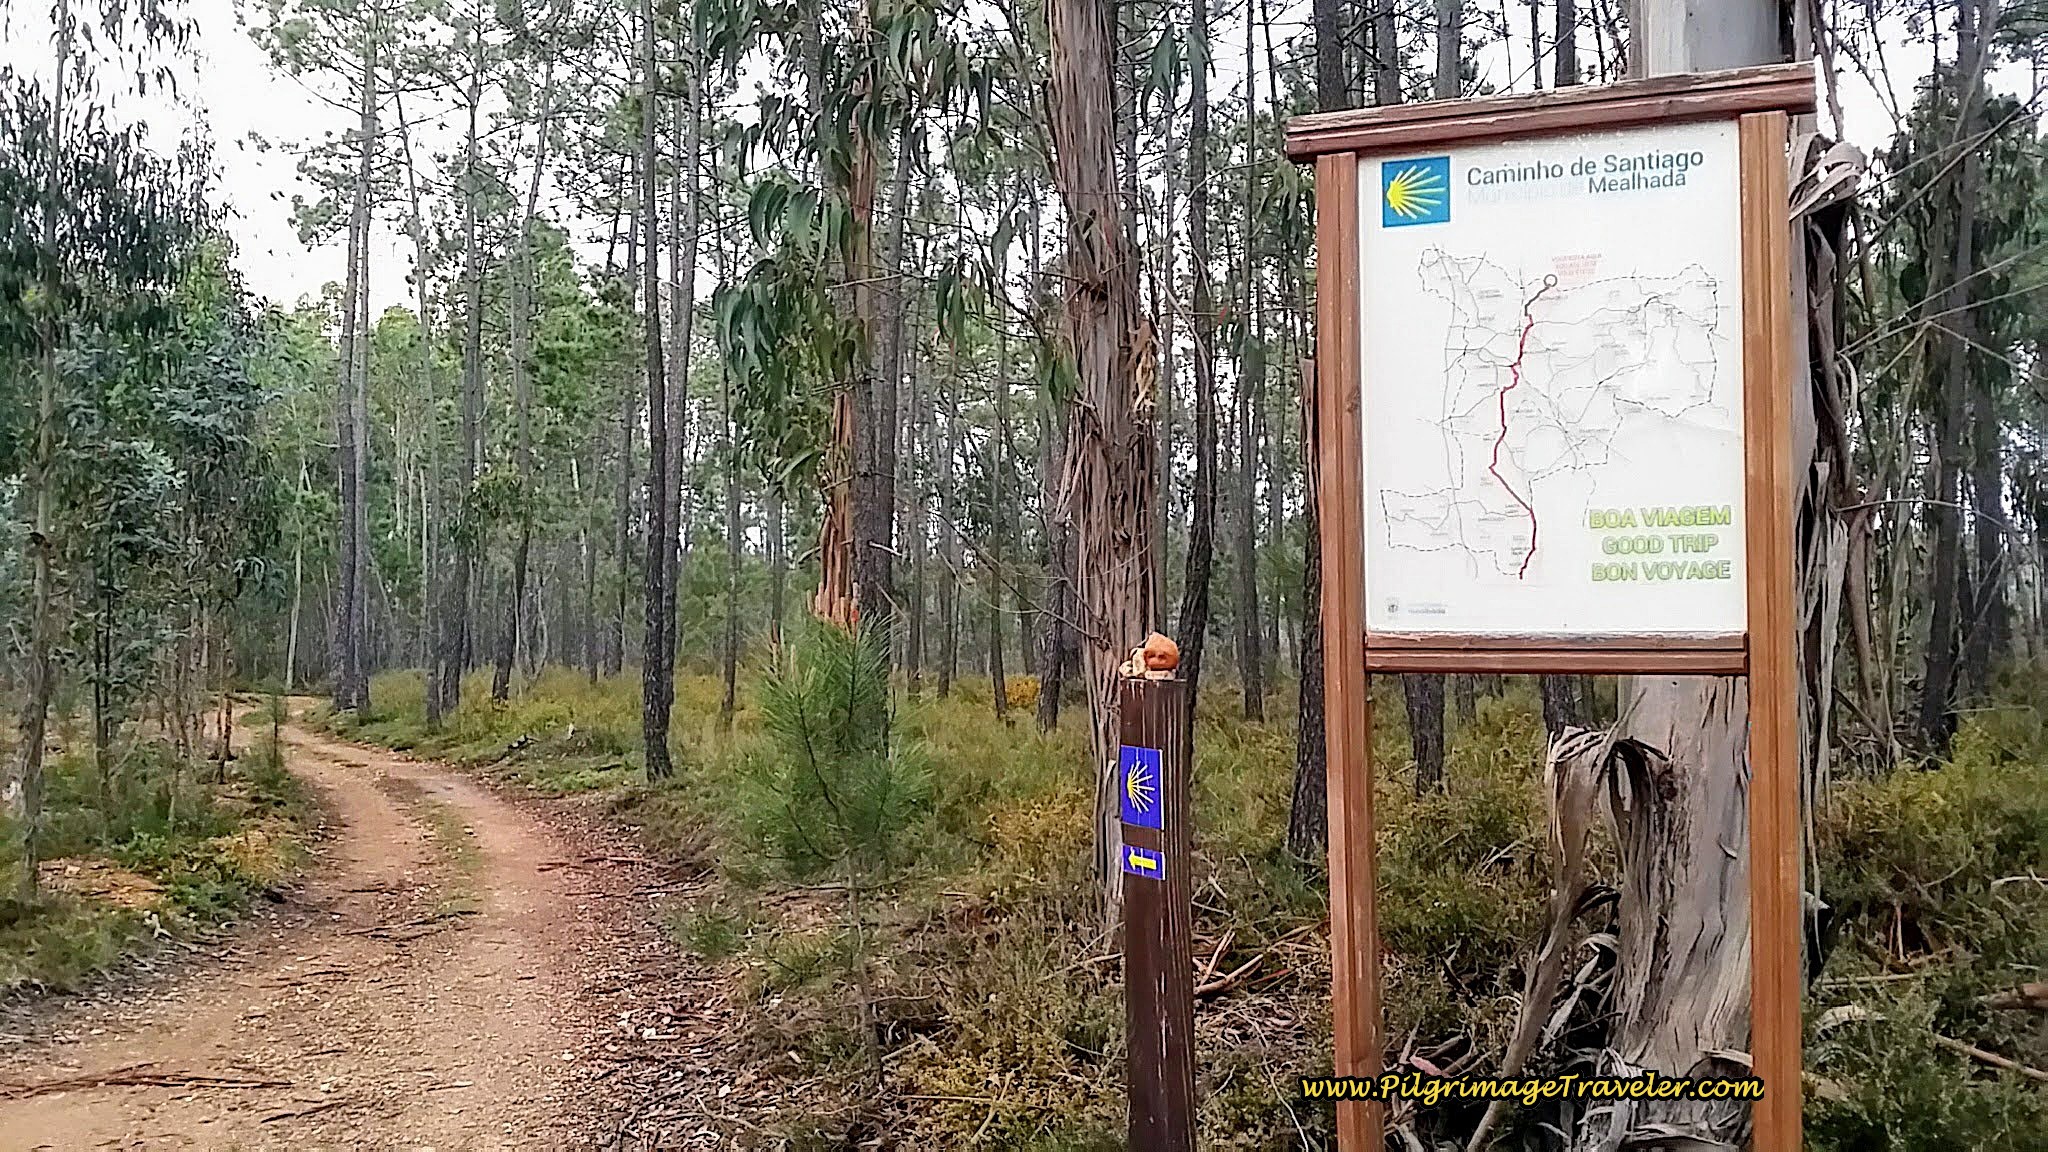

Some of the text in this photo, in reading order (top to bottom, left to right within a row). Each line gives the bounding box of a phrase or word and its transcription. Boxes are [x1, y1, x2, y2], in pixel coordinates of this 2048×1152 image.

[1467, 149, 1704, 186] Caminho de Santiago
[1589, 505, 1732, 529] BOA VIAGEM
[1601, 533, 1719, 554] GOOD TRIP
[1591, 560, 1732, 582] BON VOYAGE
